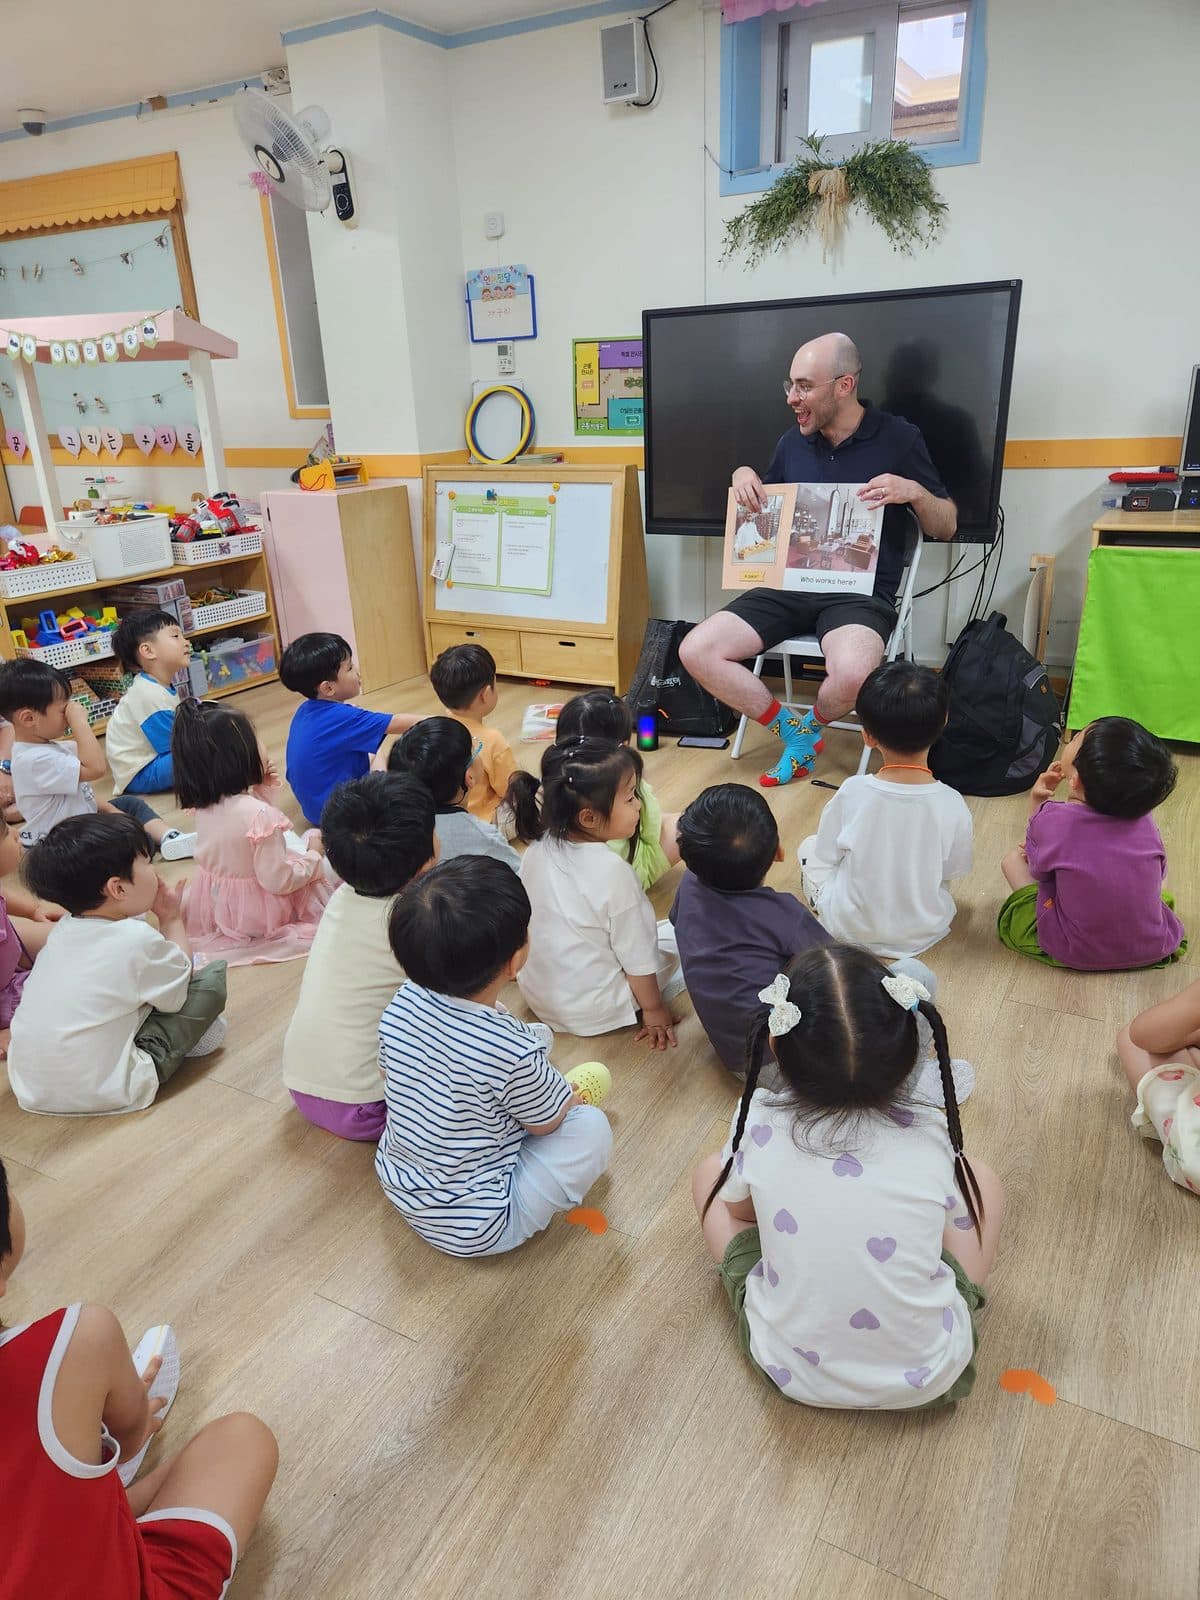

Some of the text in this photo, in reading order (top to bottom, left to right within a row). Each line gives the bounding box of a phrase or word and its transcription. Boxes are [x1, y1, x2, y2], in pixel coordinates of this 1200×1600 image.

[801, 576, 857, 586] Who works here?
